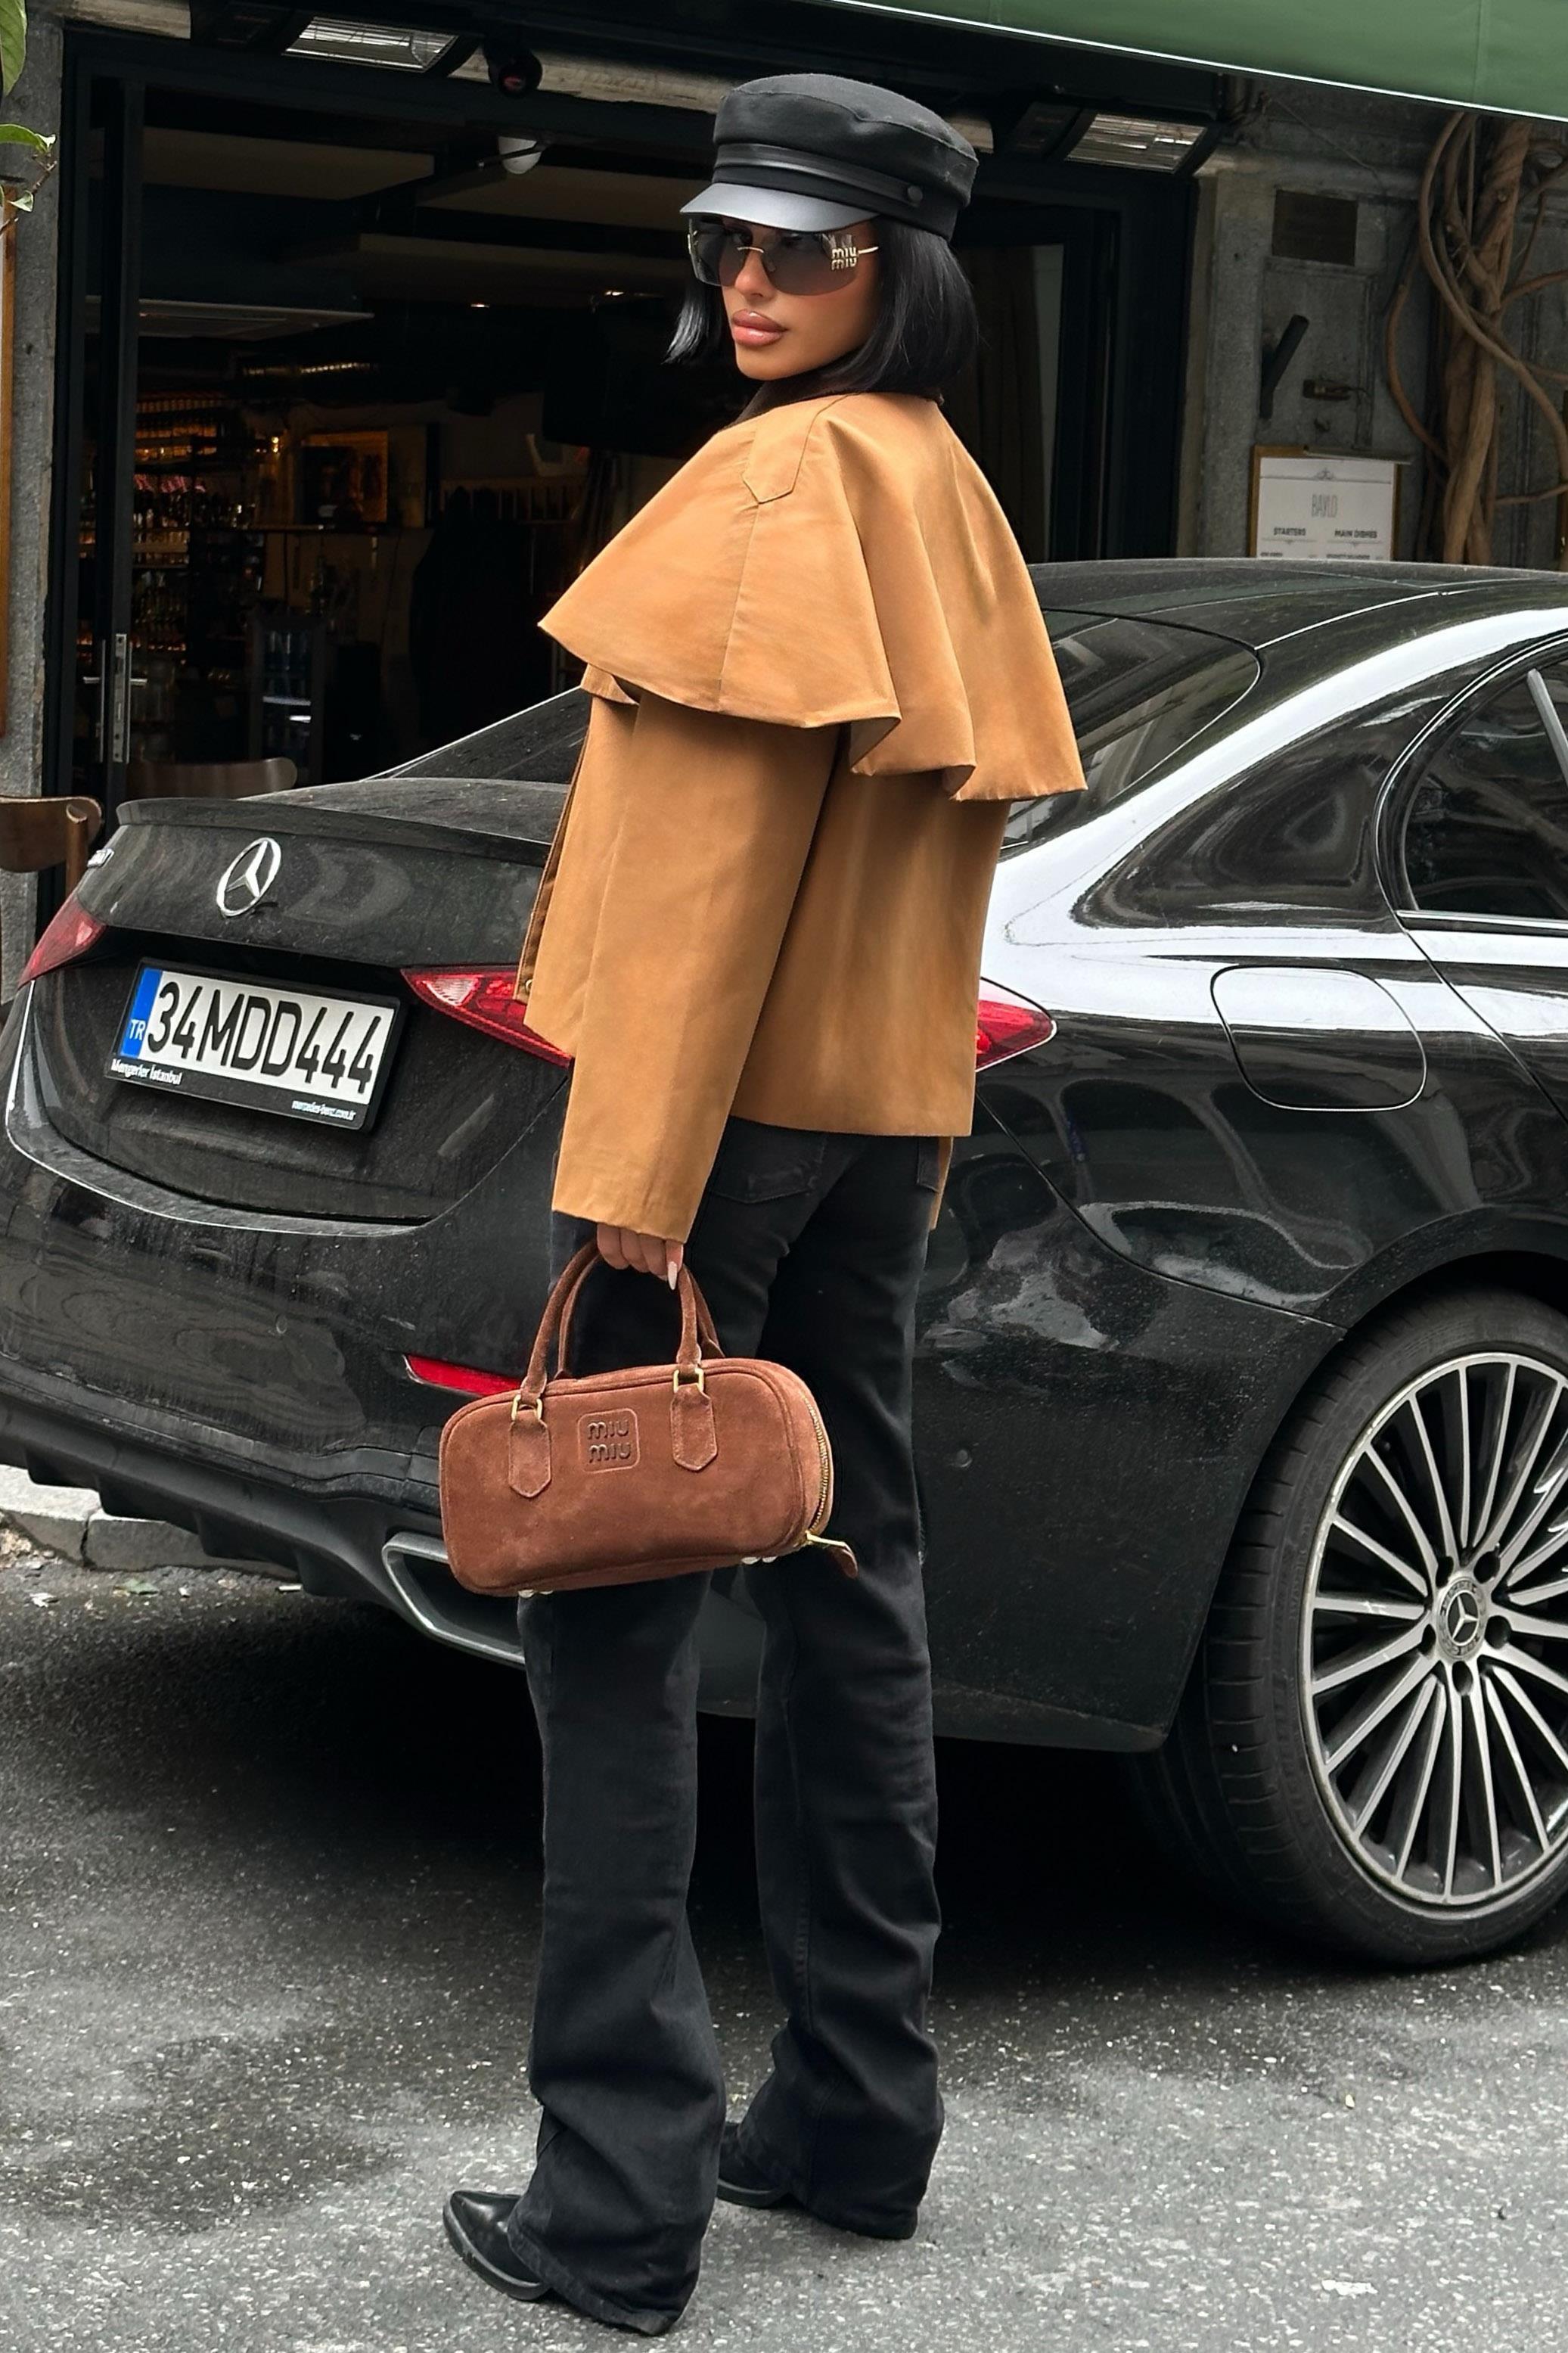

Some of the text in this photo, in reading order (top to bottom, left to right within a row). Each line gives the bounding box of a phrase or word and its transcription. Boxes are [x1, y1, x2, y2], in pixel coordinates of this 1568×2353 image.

[1273, 527, 1306, 536] STARTERS
[1353, 530, 1377, 539] DISHES
[129, 1018, 145, 1041] TR
[147, 981, 381, 1095] 34MDD444
